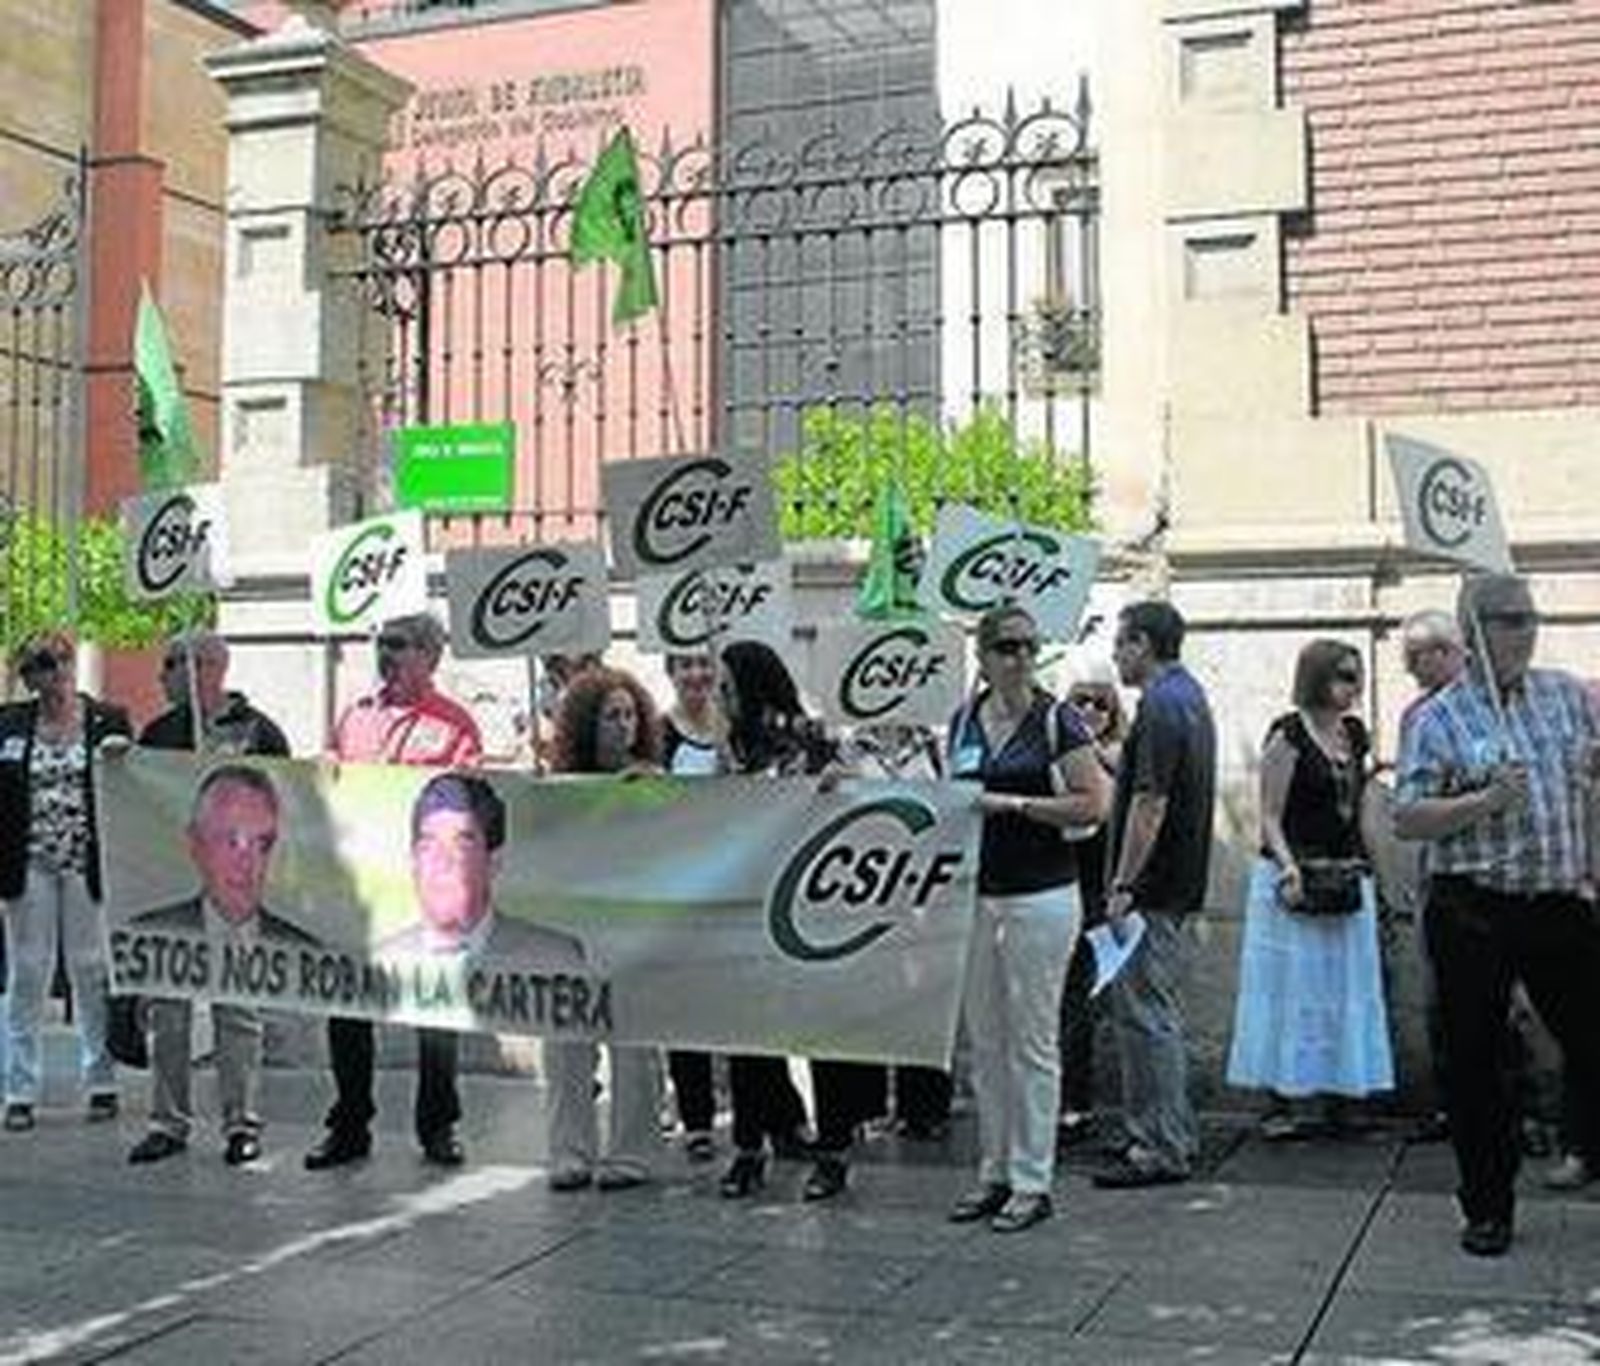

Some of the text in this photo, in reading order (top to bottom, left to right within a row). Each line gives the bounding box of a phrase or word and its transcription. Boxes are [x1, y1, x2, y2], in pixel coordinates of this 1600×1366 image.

[111, 931, 208, 987] ESTOS
[219, 946, 287, 996] NOS
[414, 963, 452, 1008] LA
[466, 968, 613, 1031] CARTERA
